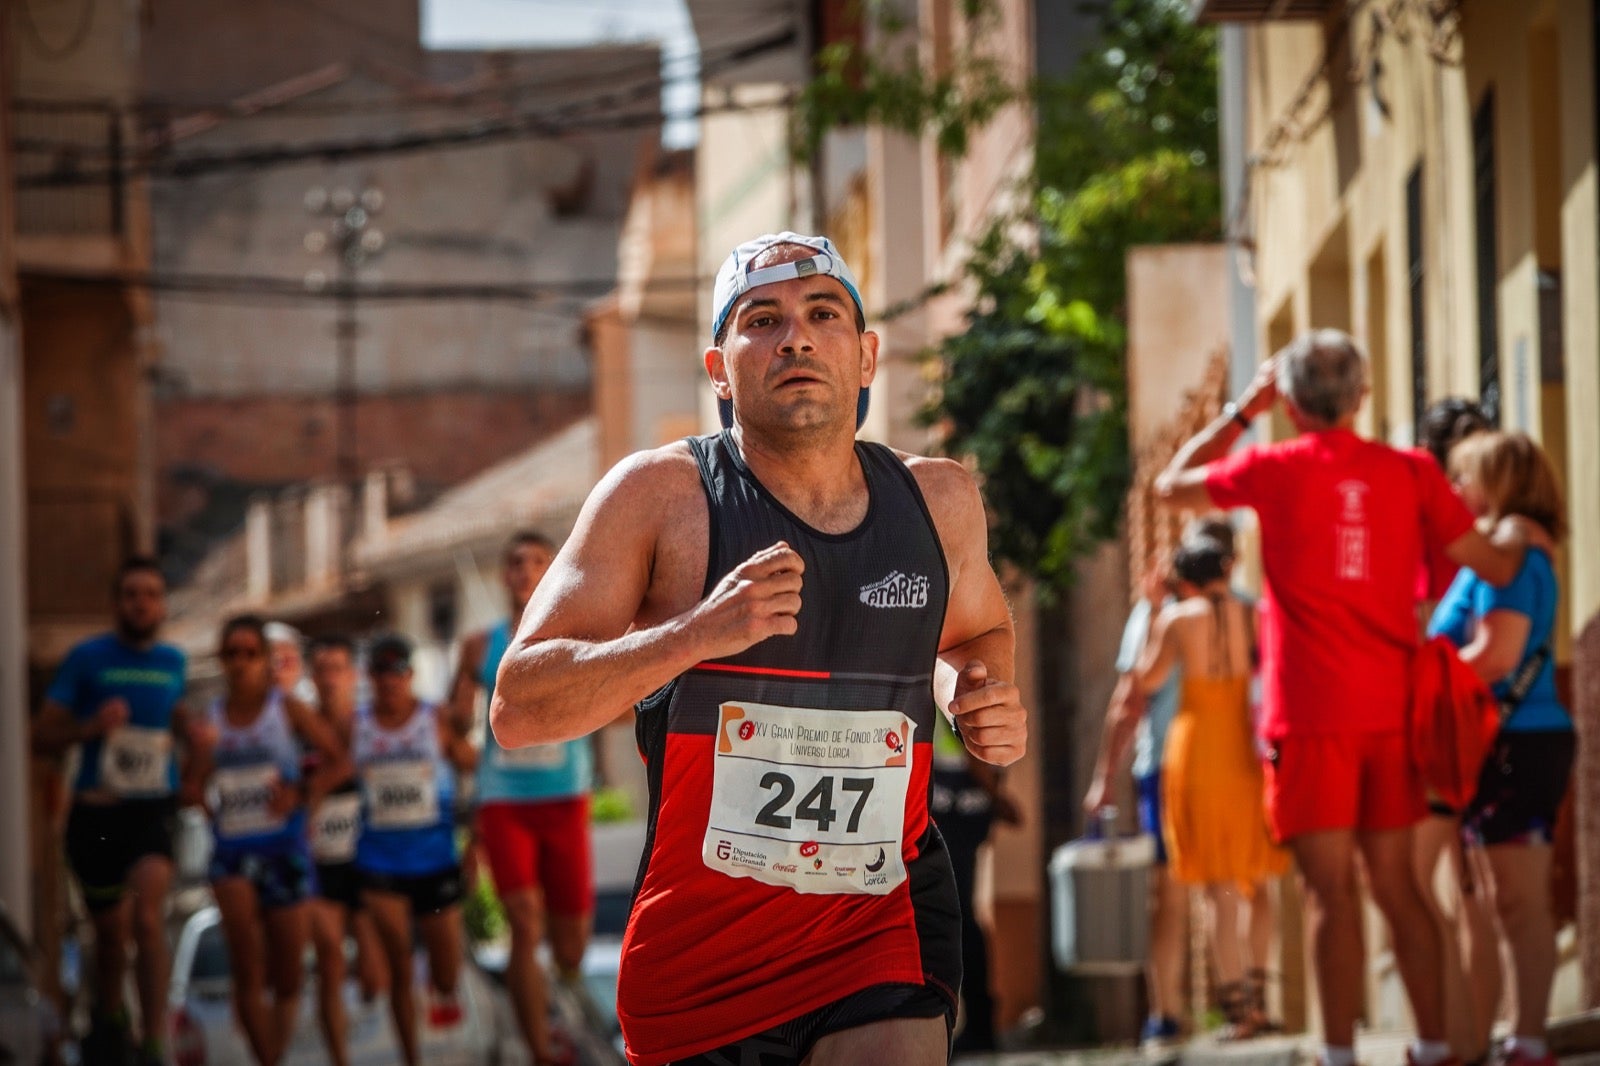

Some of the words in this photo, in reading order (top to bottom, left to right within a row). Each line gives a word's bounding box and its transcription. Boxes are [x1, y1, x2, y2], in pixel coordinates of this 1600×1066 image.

[868, 577, 925, 605] ATARFE
[872, 727, 892, 744] 202
[755, 771, 874, 833] 247
[733, 847, 767, 860] Diputación
[740, 856, 766, 867] Granada
